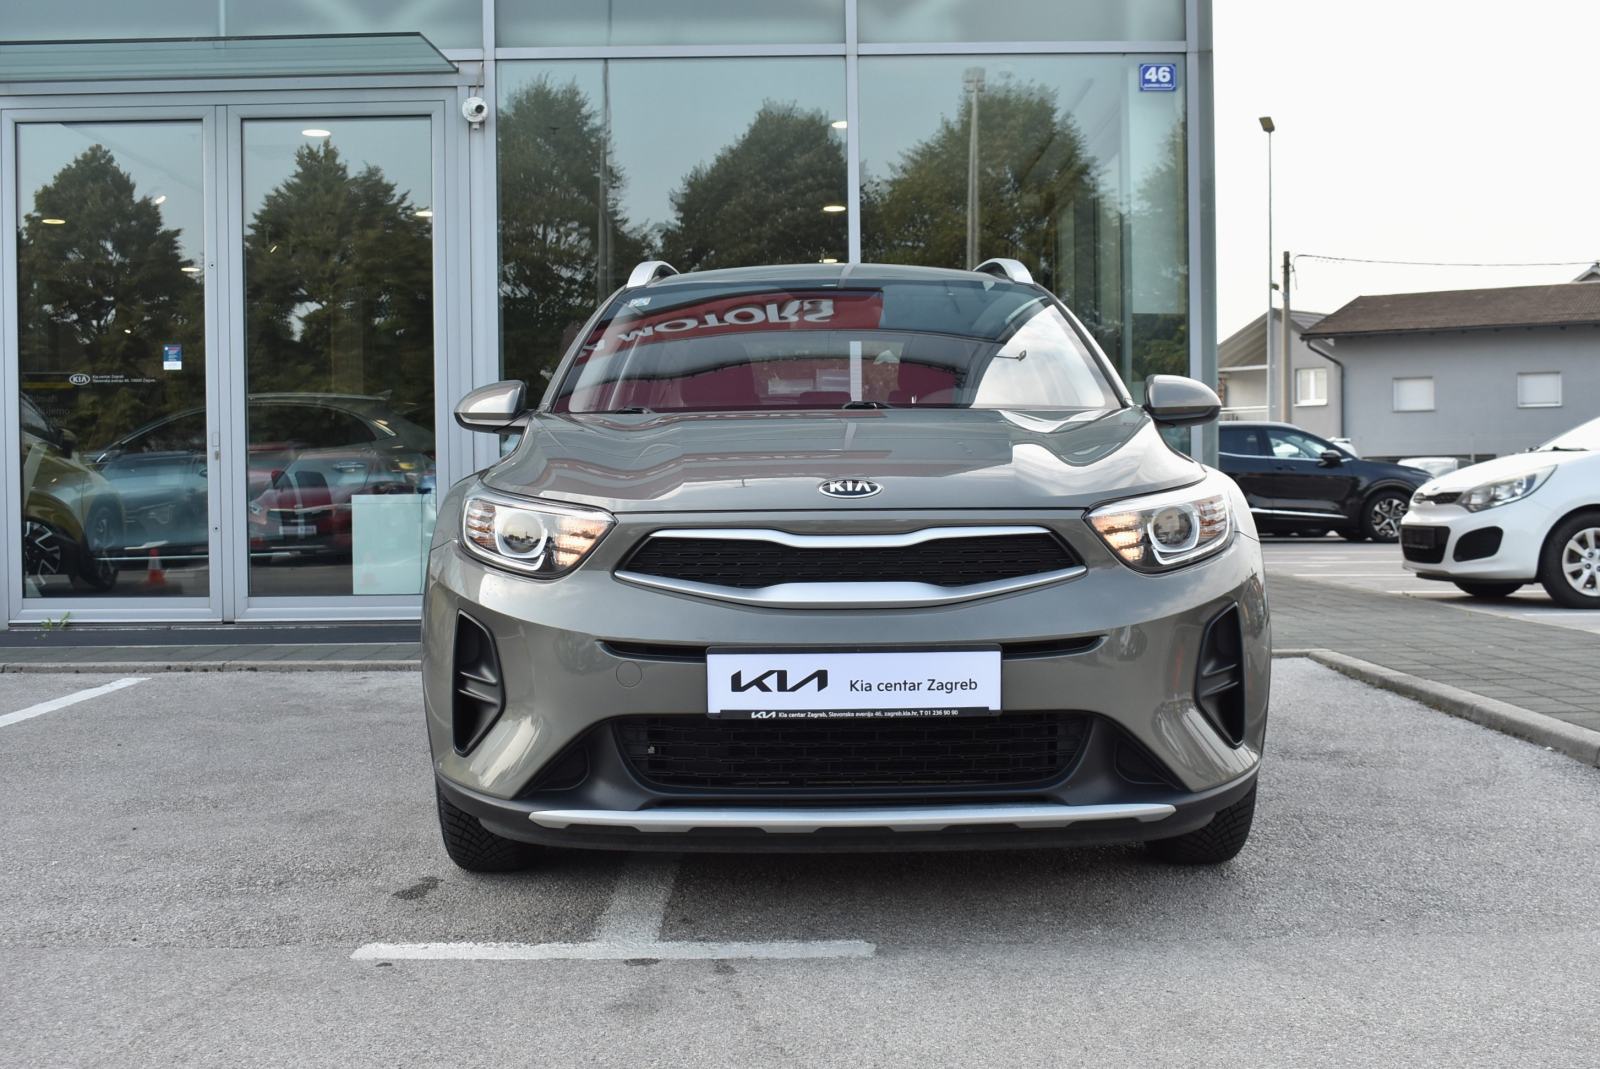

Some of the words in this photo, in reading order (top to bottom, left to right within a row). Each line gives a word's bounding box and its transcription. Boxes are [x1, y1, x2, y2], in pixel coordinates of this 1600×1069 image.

[1144, 66, 1171, 83] 46
[829, 480, 872, 493] KIA
[731, 669, 828, 693] KIA
[850, 680, 873, 692] Kia
[877, 680, 923, 692] centar
[927, 678, 978, 694] Zagreb
[751, 711, 777, 719] KIA
